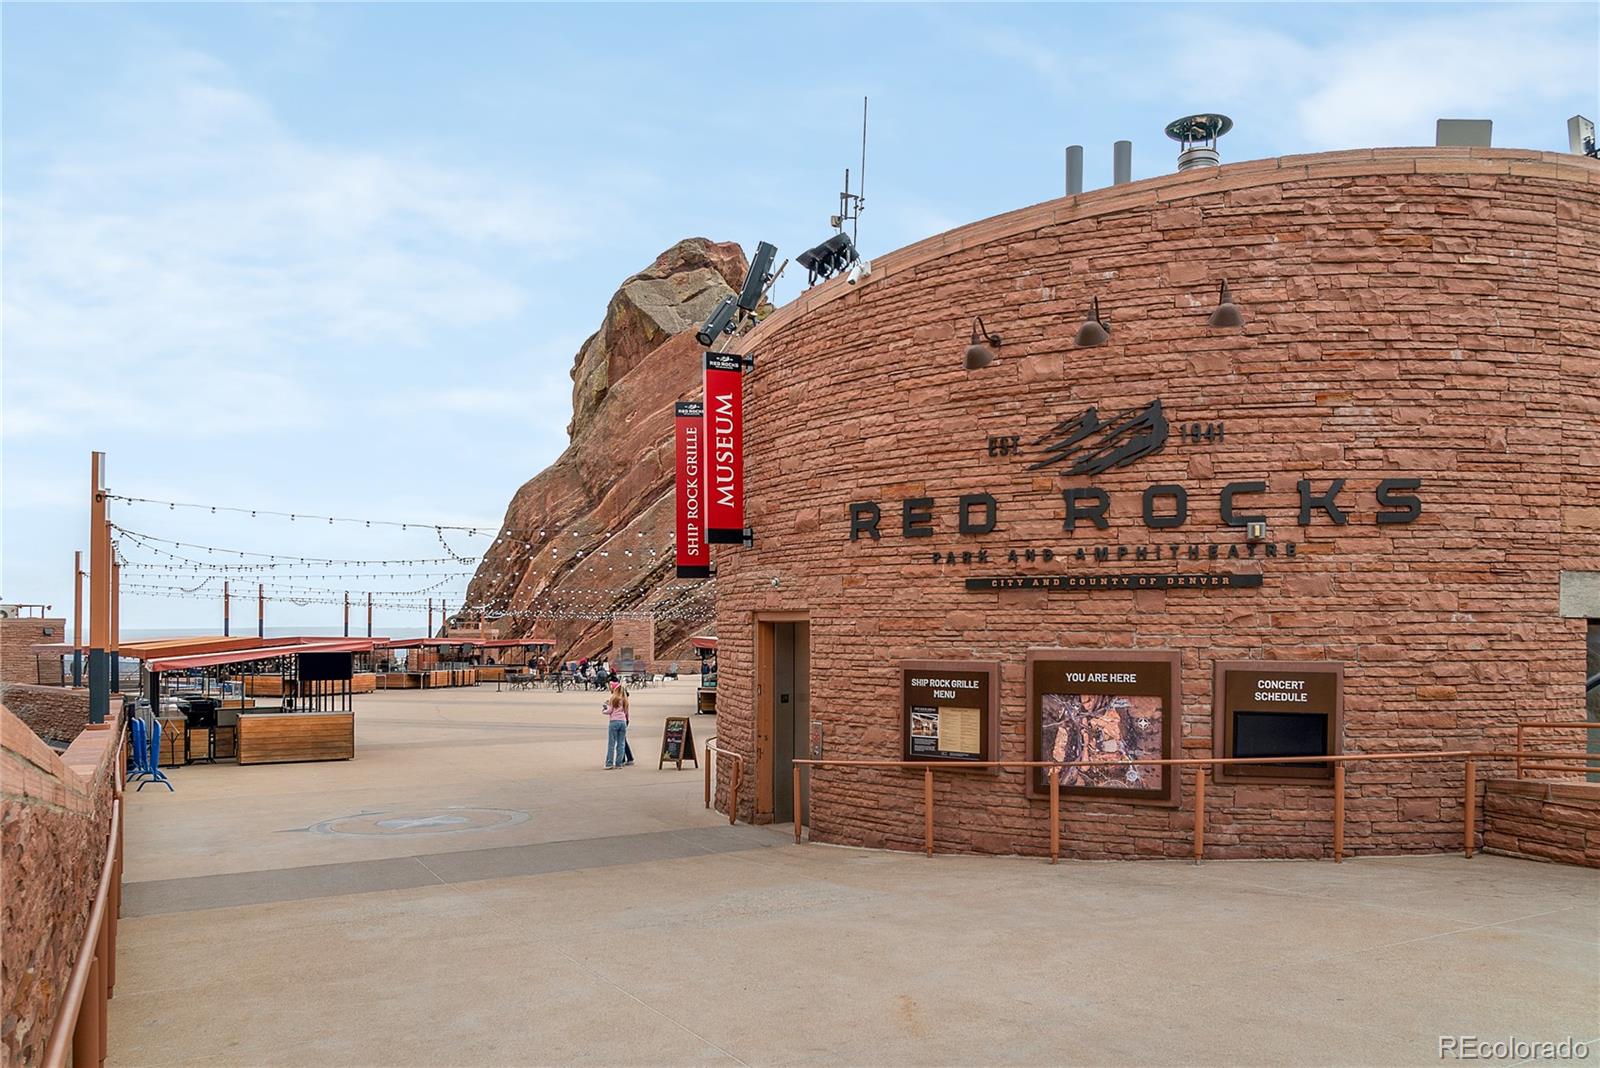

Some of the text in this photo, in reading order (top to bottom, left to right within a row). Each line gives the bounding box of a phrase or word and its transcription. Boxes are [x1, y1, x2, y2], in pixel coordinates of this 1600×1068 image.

[1181, 422, 1225, 445] 1941
[686, 427, 698, 476] GRILLE
[715, 393, 735, 508] MUSEUM
[988, 434, 1024, 458] EST.
[686, 478, 698, 519] ROCK
[850, 478, 1421, 542] RED ROCKS
[687, 522, 699, 556] SHIP
[932, 542, 1297, 565] PARK AND AMPHITHEATRE
[991, 577, 1231, 587] CITY AND COUNTY OF DENVER
[911, 678, 979, 689] SHIP ROCK GRILLE
[1065, 672, 1137, 683] YOU ARE HERE
[1257, 680, 1305, 690] CONCERT
[933, 689, 956, 699] MENU
[1254, 691, 1308, 702] SCHEDULE
